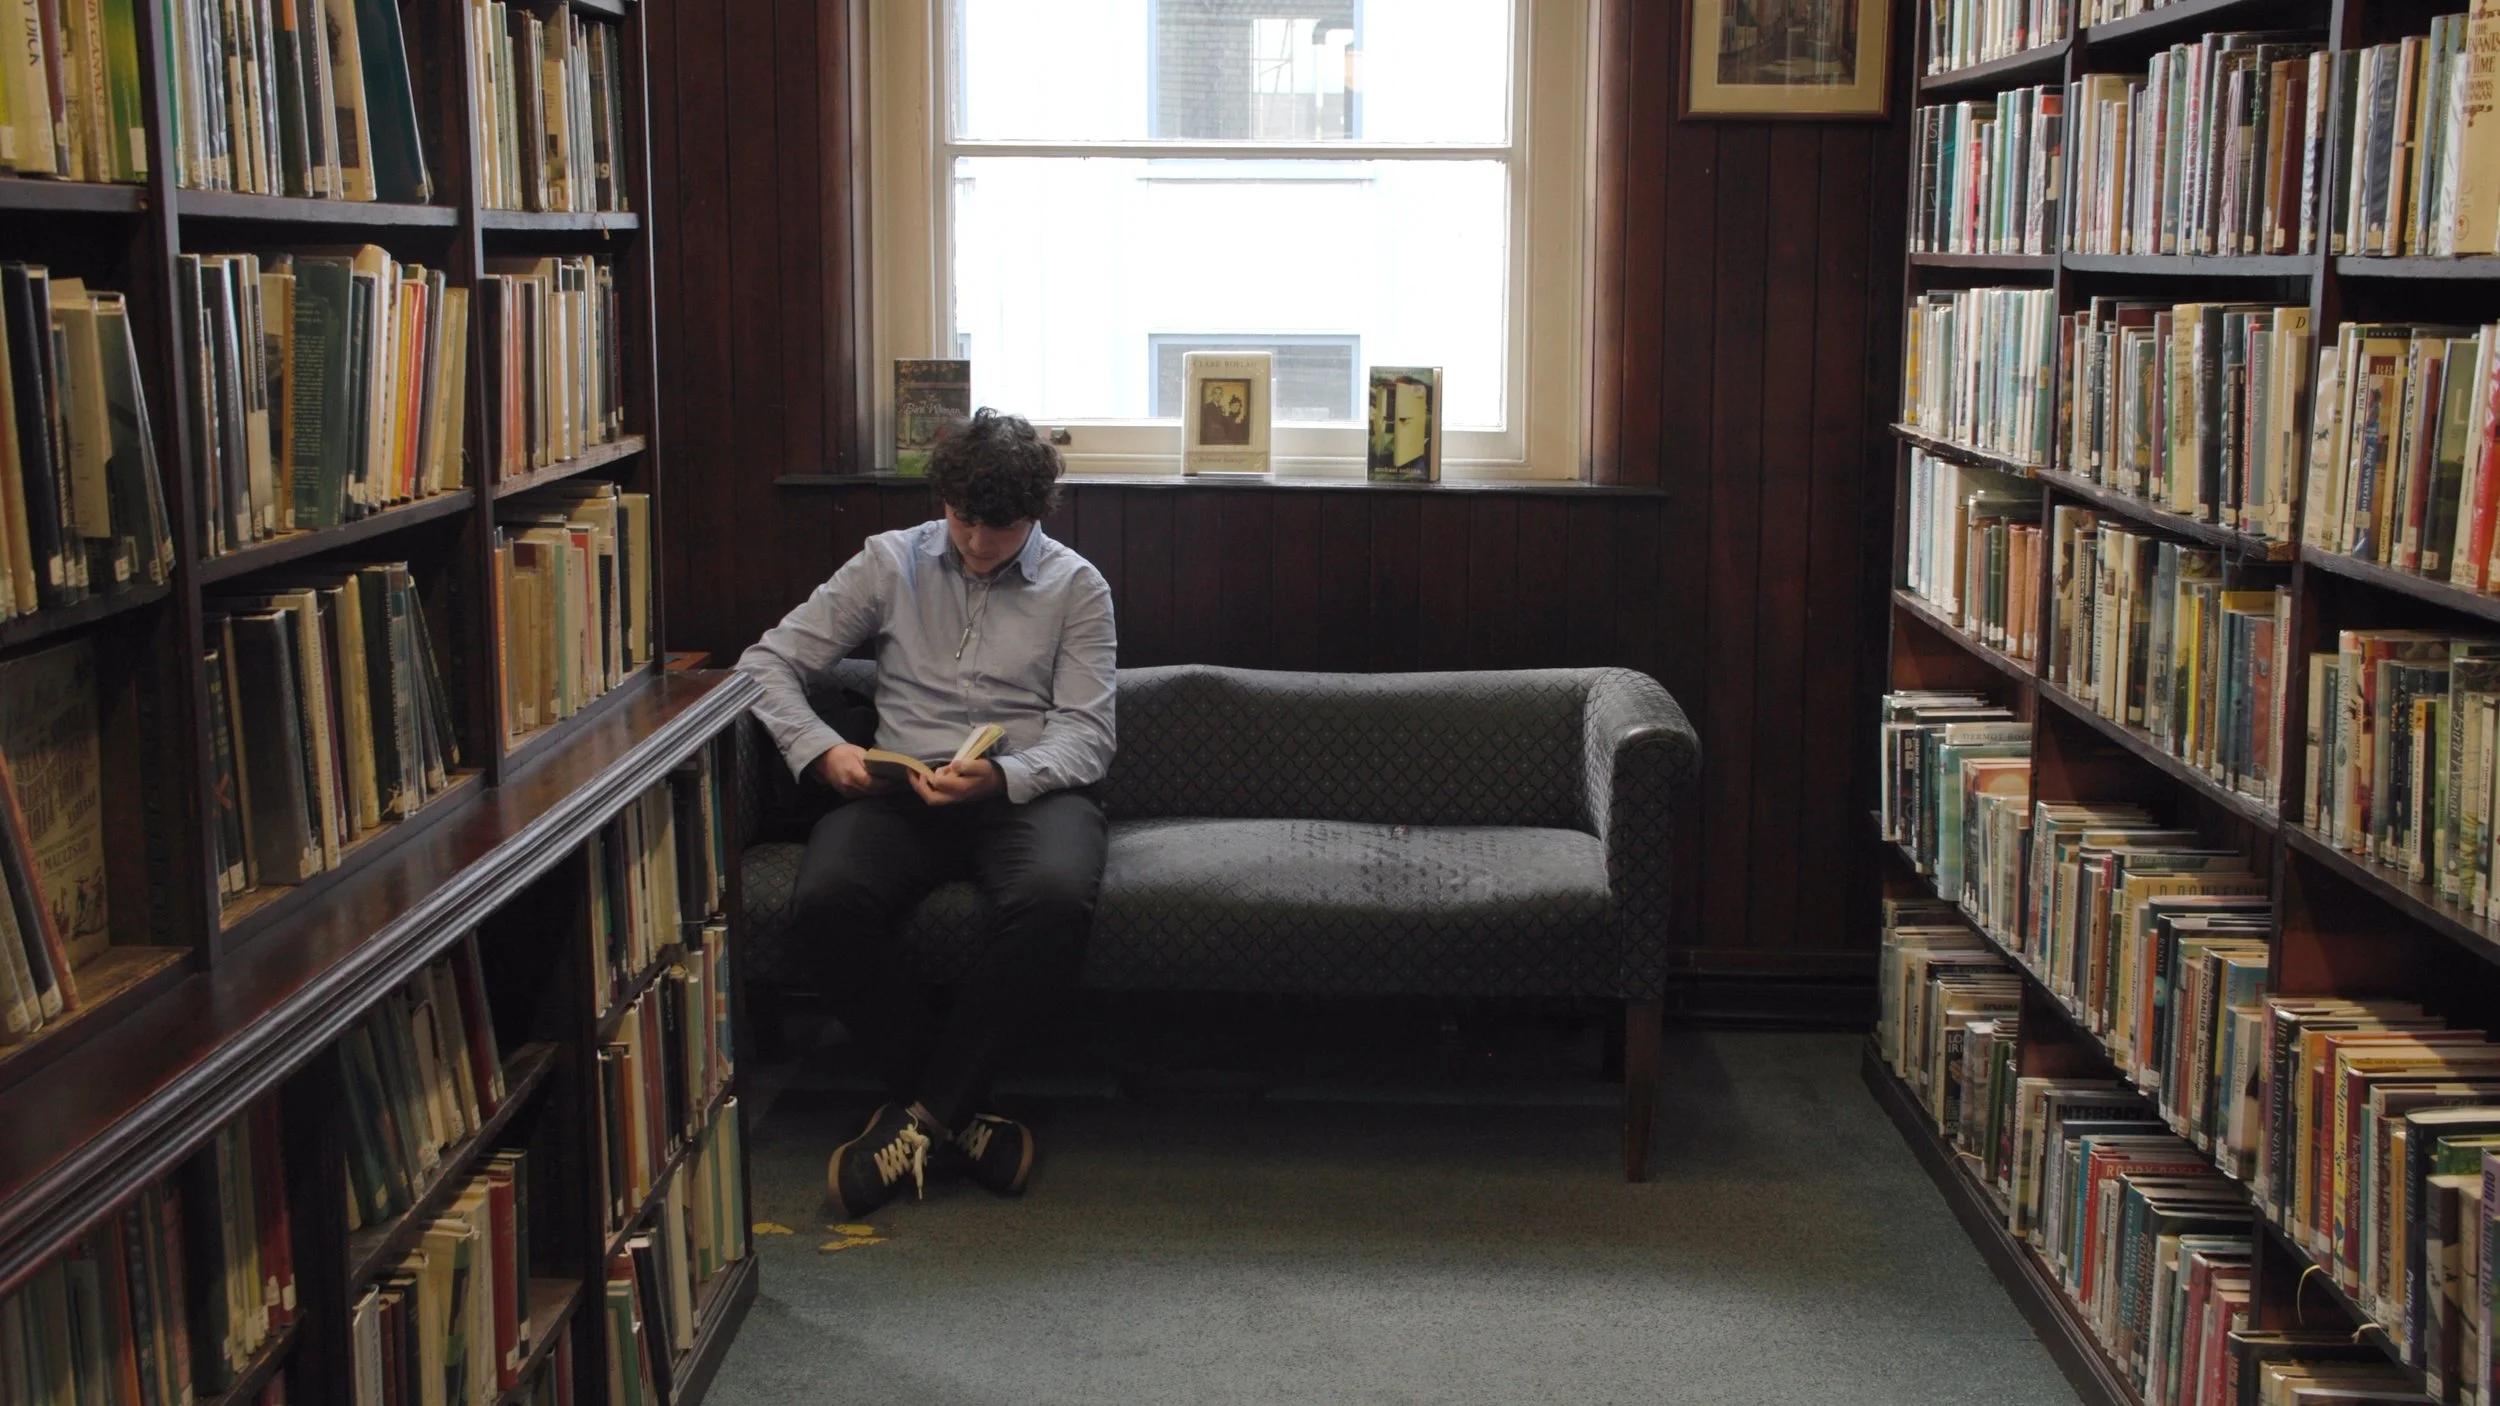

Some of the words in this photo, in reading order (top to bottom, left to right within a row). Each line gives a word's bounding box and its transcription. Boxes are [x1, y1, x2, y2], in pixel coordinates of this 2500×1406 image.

[25, 18, 40, 66] DICK
[2296, 316, 2306, 329] D
[1193, 360, 1221, 369] CLARE
[2362, 445, 2374, 465] bog
[2450, 711, 2464, 754] Bird
[2199, 973, 2209, 1031] FOOTBALLER
[2274, 1020, 2289, 1065] HEALY
[2270, 1130, 2282, 1167] SONG
[2406, 1127, 2416, 1163] SEAN
[2105, 1163, 2152, 1178] RODDY
[2484, 1170, 2496, 1201] OUR
[2349, 1199, 2360, 1232] Serpent
[2138, 1231, 2149, 1285] RODDY
[2482, 1267, 2492, 1311] LIVES
[2132, 1288, 2145, 1337] DOYLE
